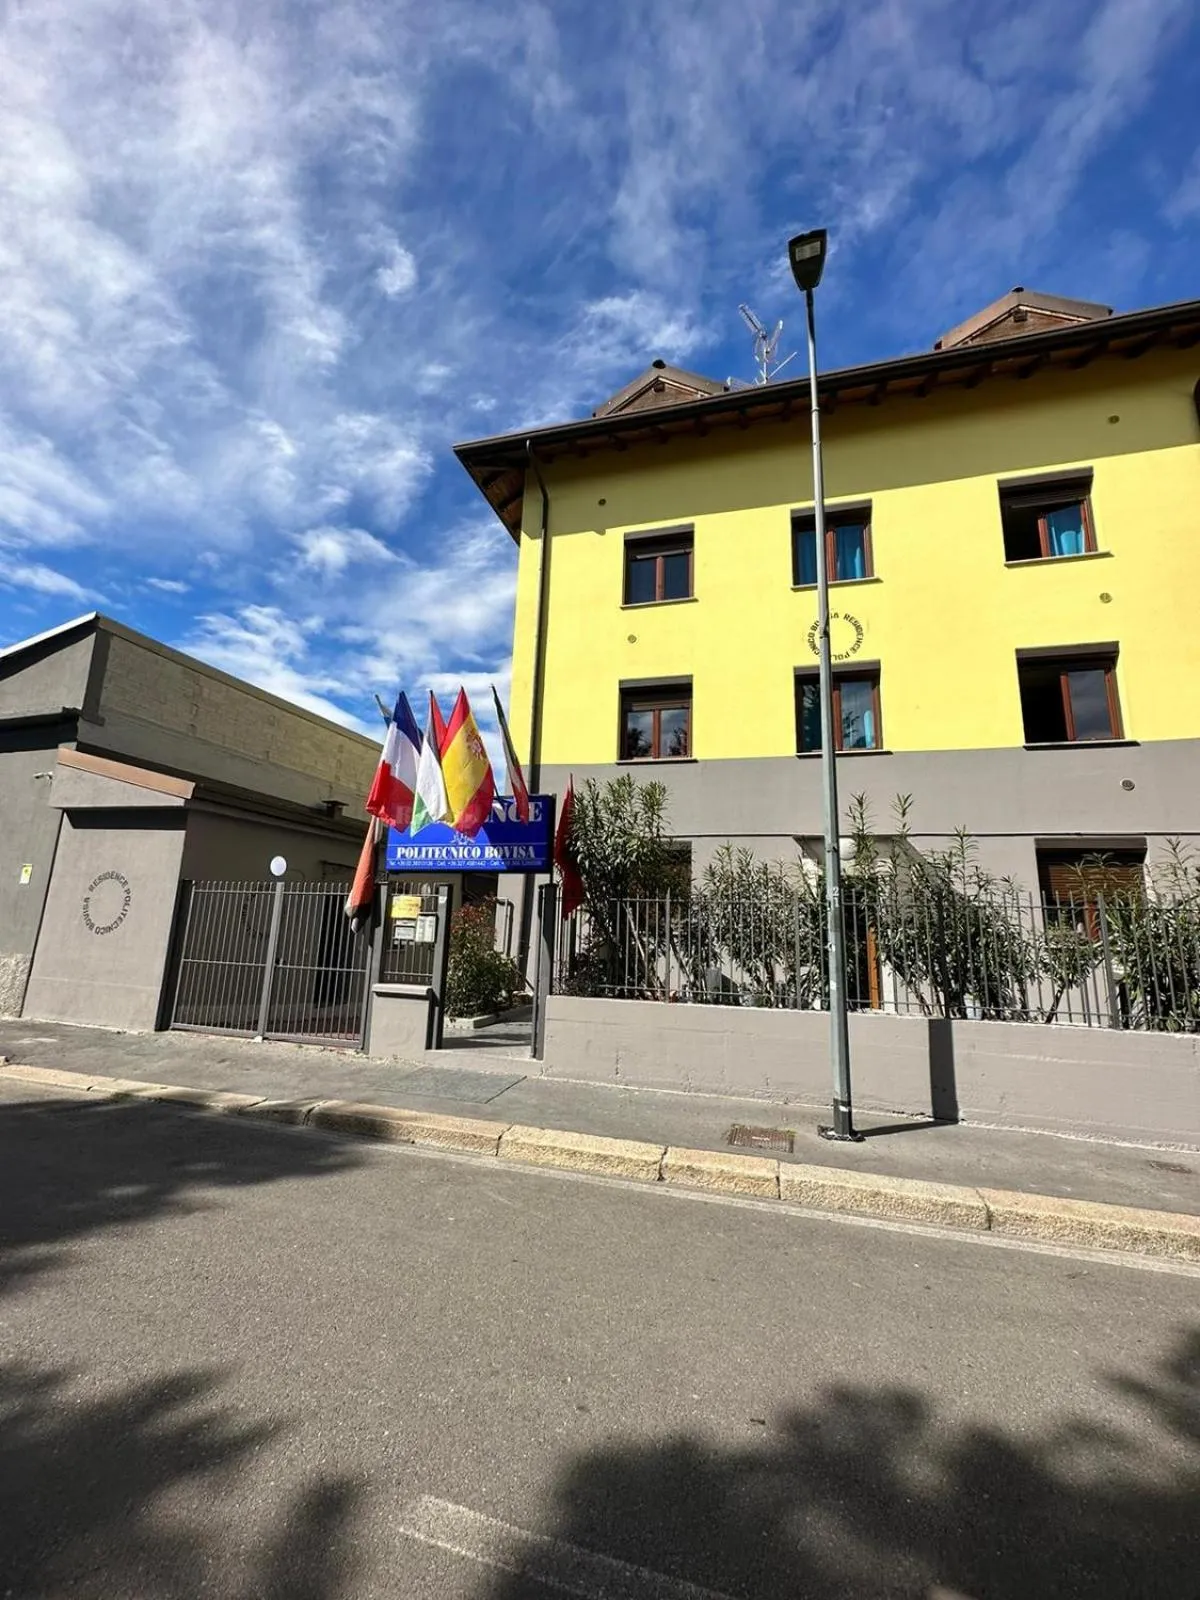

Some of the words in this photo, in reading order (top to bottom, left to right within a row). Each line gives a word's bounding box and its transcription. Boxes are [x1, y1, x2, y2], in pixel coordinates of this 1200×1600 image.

[843, 613, 864, 654] RESIDENCE
[396, 846, 481, 859] POLITECNICO
[484, 846, 536, 859] BOVISA
[88, 871, 128, 892] RESIDENCE
[82, 897, 95, 930] BOVISA
[94, 888, 131, 935] POLITECNICO
